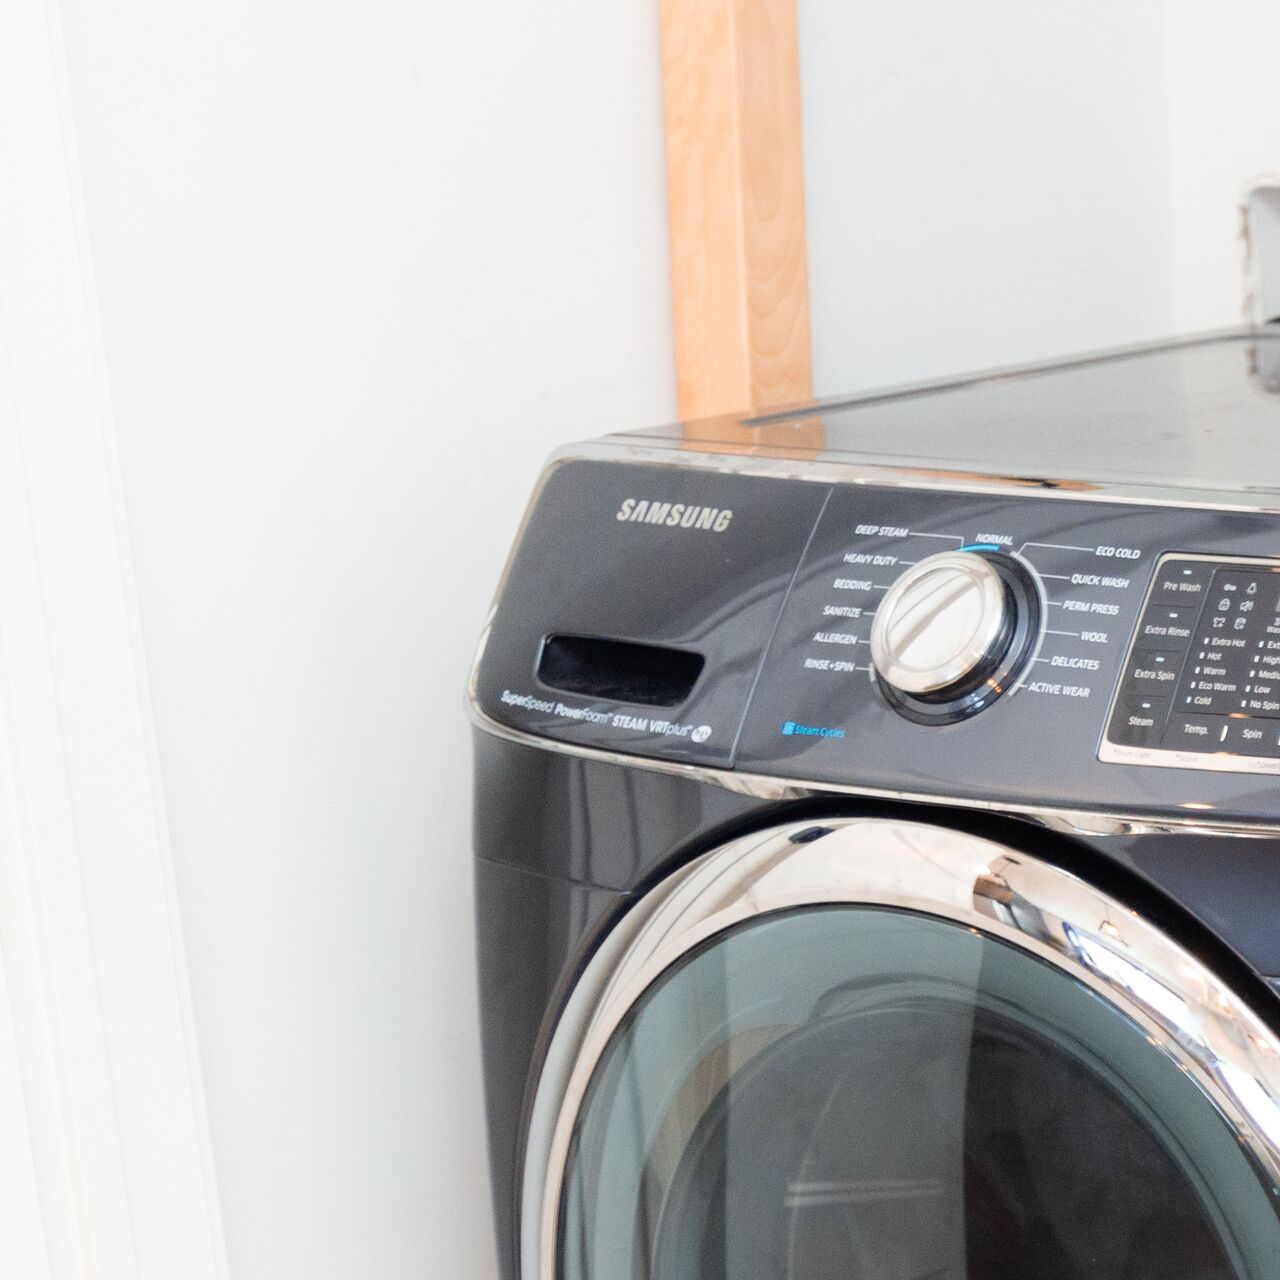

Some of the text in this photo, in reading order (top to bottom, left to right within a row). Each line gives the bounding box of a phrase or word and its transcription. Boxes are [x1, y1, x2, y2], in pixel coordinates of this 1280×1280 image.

[616, 498, 733, 532] SAMSUNG
[855, 525, 909, 537] DEEP STEAM
[976, 534, 1013, 546] NORMAL
[1096, 546, 1141, 559] ECO COLD
[844, 554, 898, 566] HEAVY DUTY
[833, 579, 872, 590] BEDDING
[1071, 574, 1129, 588] QUICK WASH
[1163, 582, 1201, 592] Pre Wash
[823, 606, 862, 617] SANITIZE
[1063, 601, 1119, 615] PERM PRESS
[1081, 632, 1108, 642] WOOL
[1145, 625, 1190, 637] Extra Rinse
[813, 632, 857, 644] ALLERGEN
[805, 659, 855, 672] RINSE+SPIN
[1051, 656, 1099, 670] DELICATES
[1134, 669, 1175, 681] Extra Spin
[1204, 667, 1226, 675] Warm
[1028, 682, 1090, 697] ACTIVE WEAR
[613, 715, 648, 731] STEAM
[1128, 716, 1153, 726] Steam
[795, 725, 846, 739] Steam Cycles
[1184, 724, 1208, 735] Temp.
[1243, 729, 1262, 739] Spin
